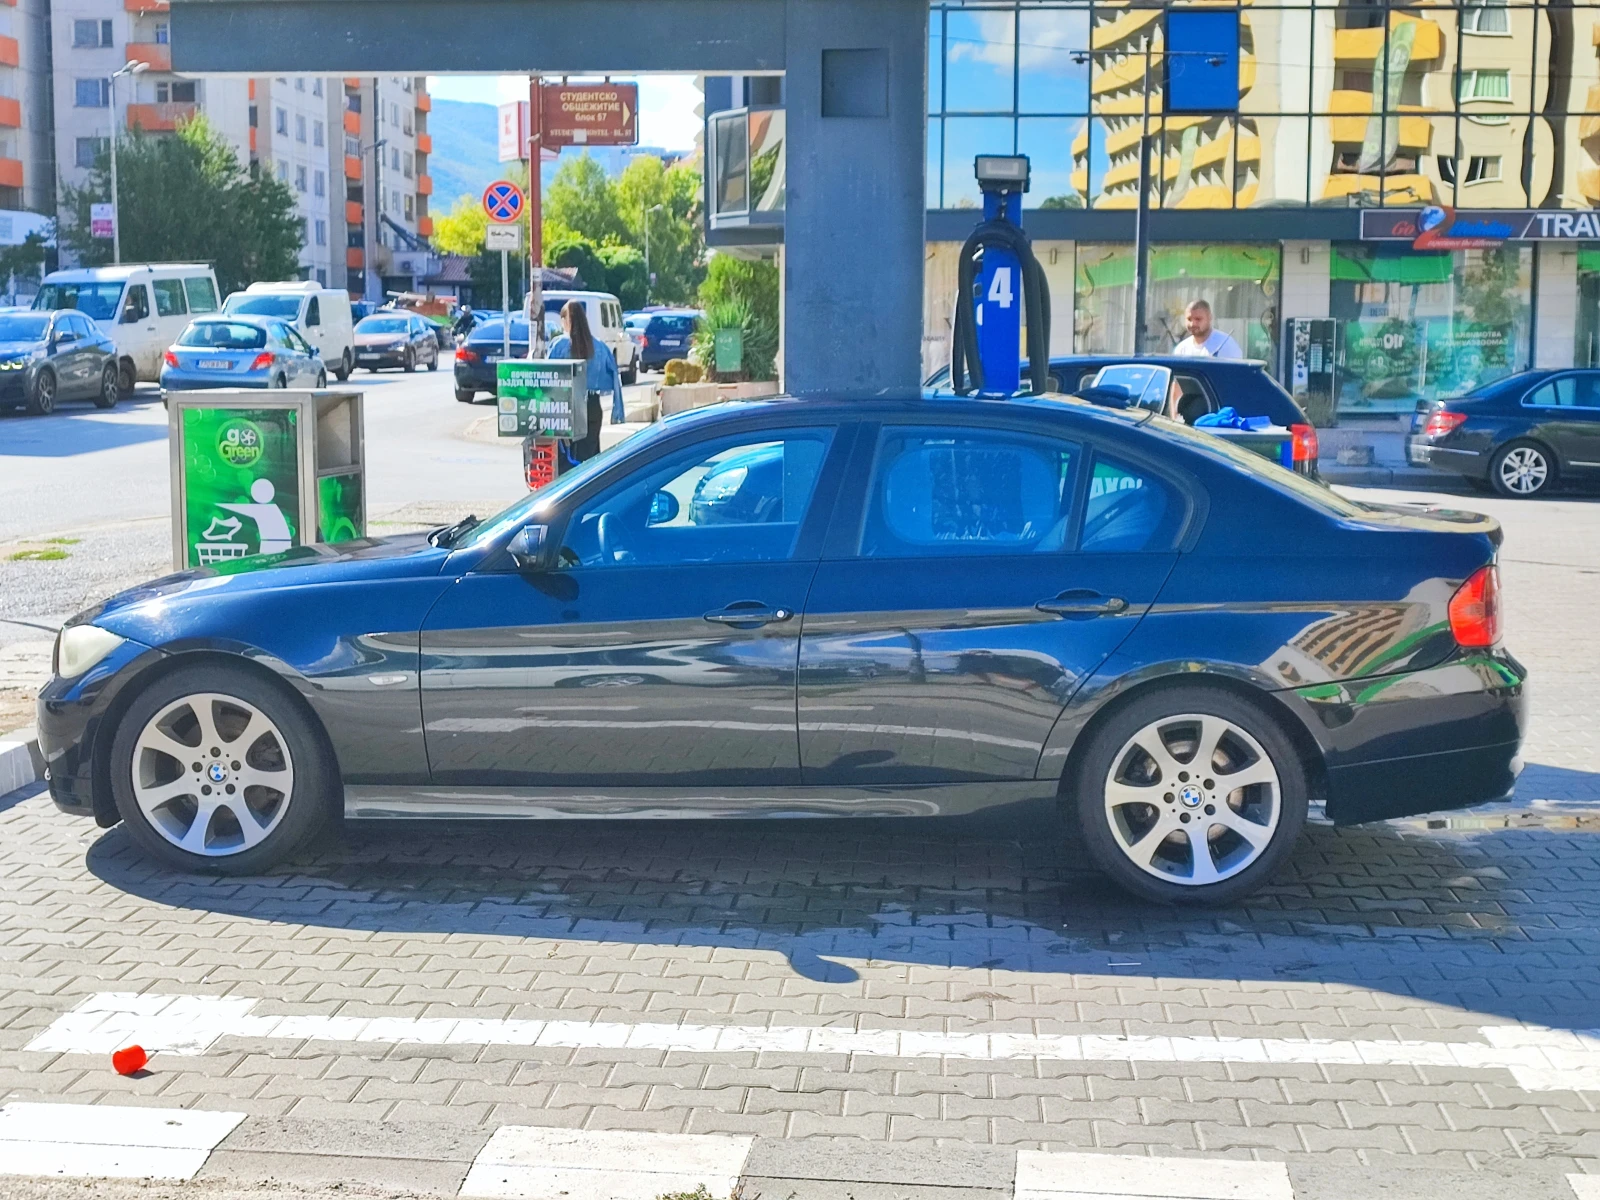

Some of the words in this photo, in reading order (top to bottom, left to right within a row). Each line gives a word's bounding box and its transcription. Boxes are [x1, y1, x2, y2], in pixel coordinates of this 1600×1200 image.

[560, 91, 618, 102] СТУДЕНТСКО
[561, 102, 620, 112] ОБЩЕЖИТИЕ
[574, 112, 595, 121] блок
[1391, 221, 1416, 236] Go
[988, 267, 1013, 308] 4
[528, 398, 537, 413] 4
[540, 401, 572, 414] МИН.
[528, 415, 537, 430] 2
[540, 418, 572, 430] МИН.
[219, 440, 260, 458] Green
